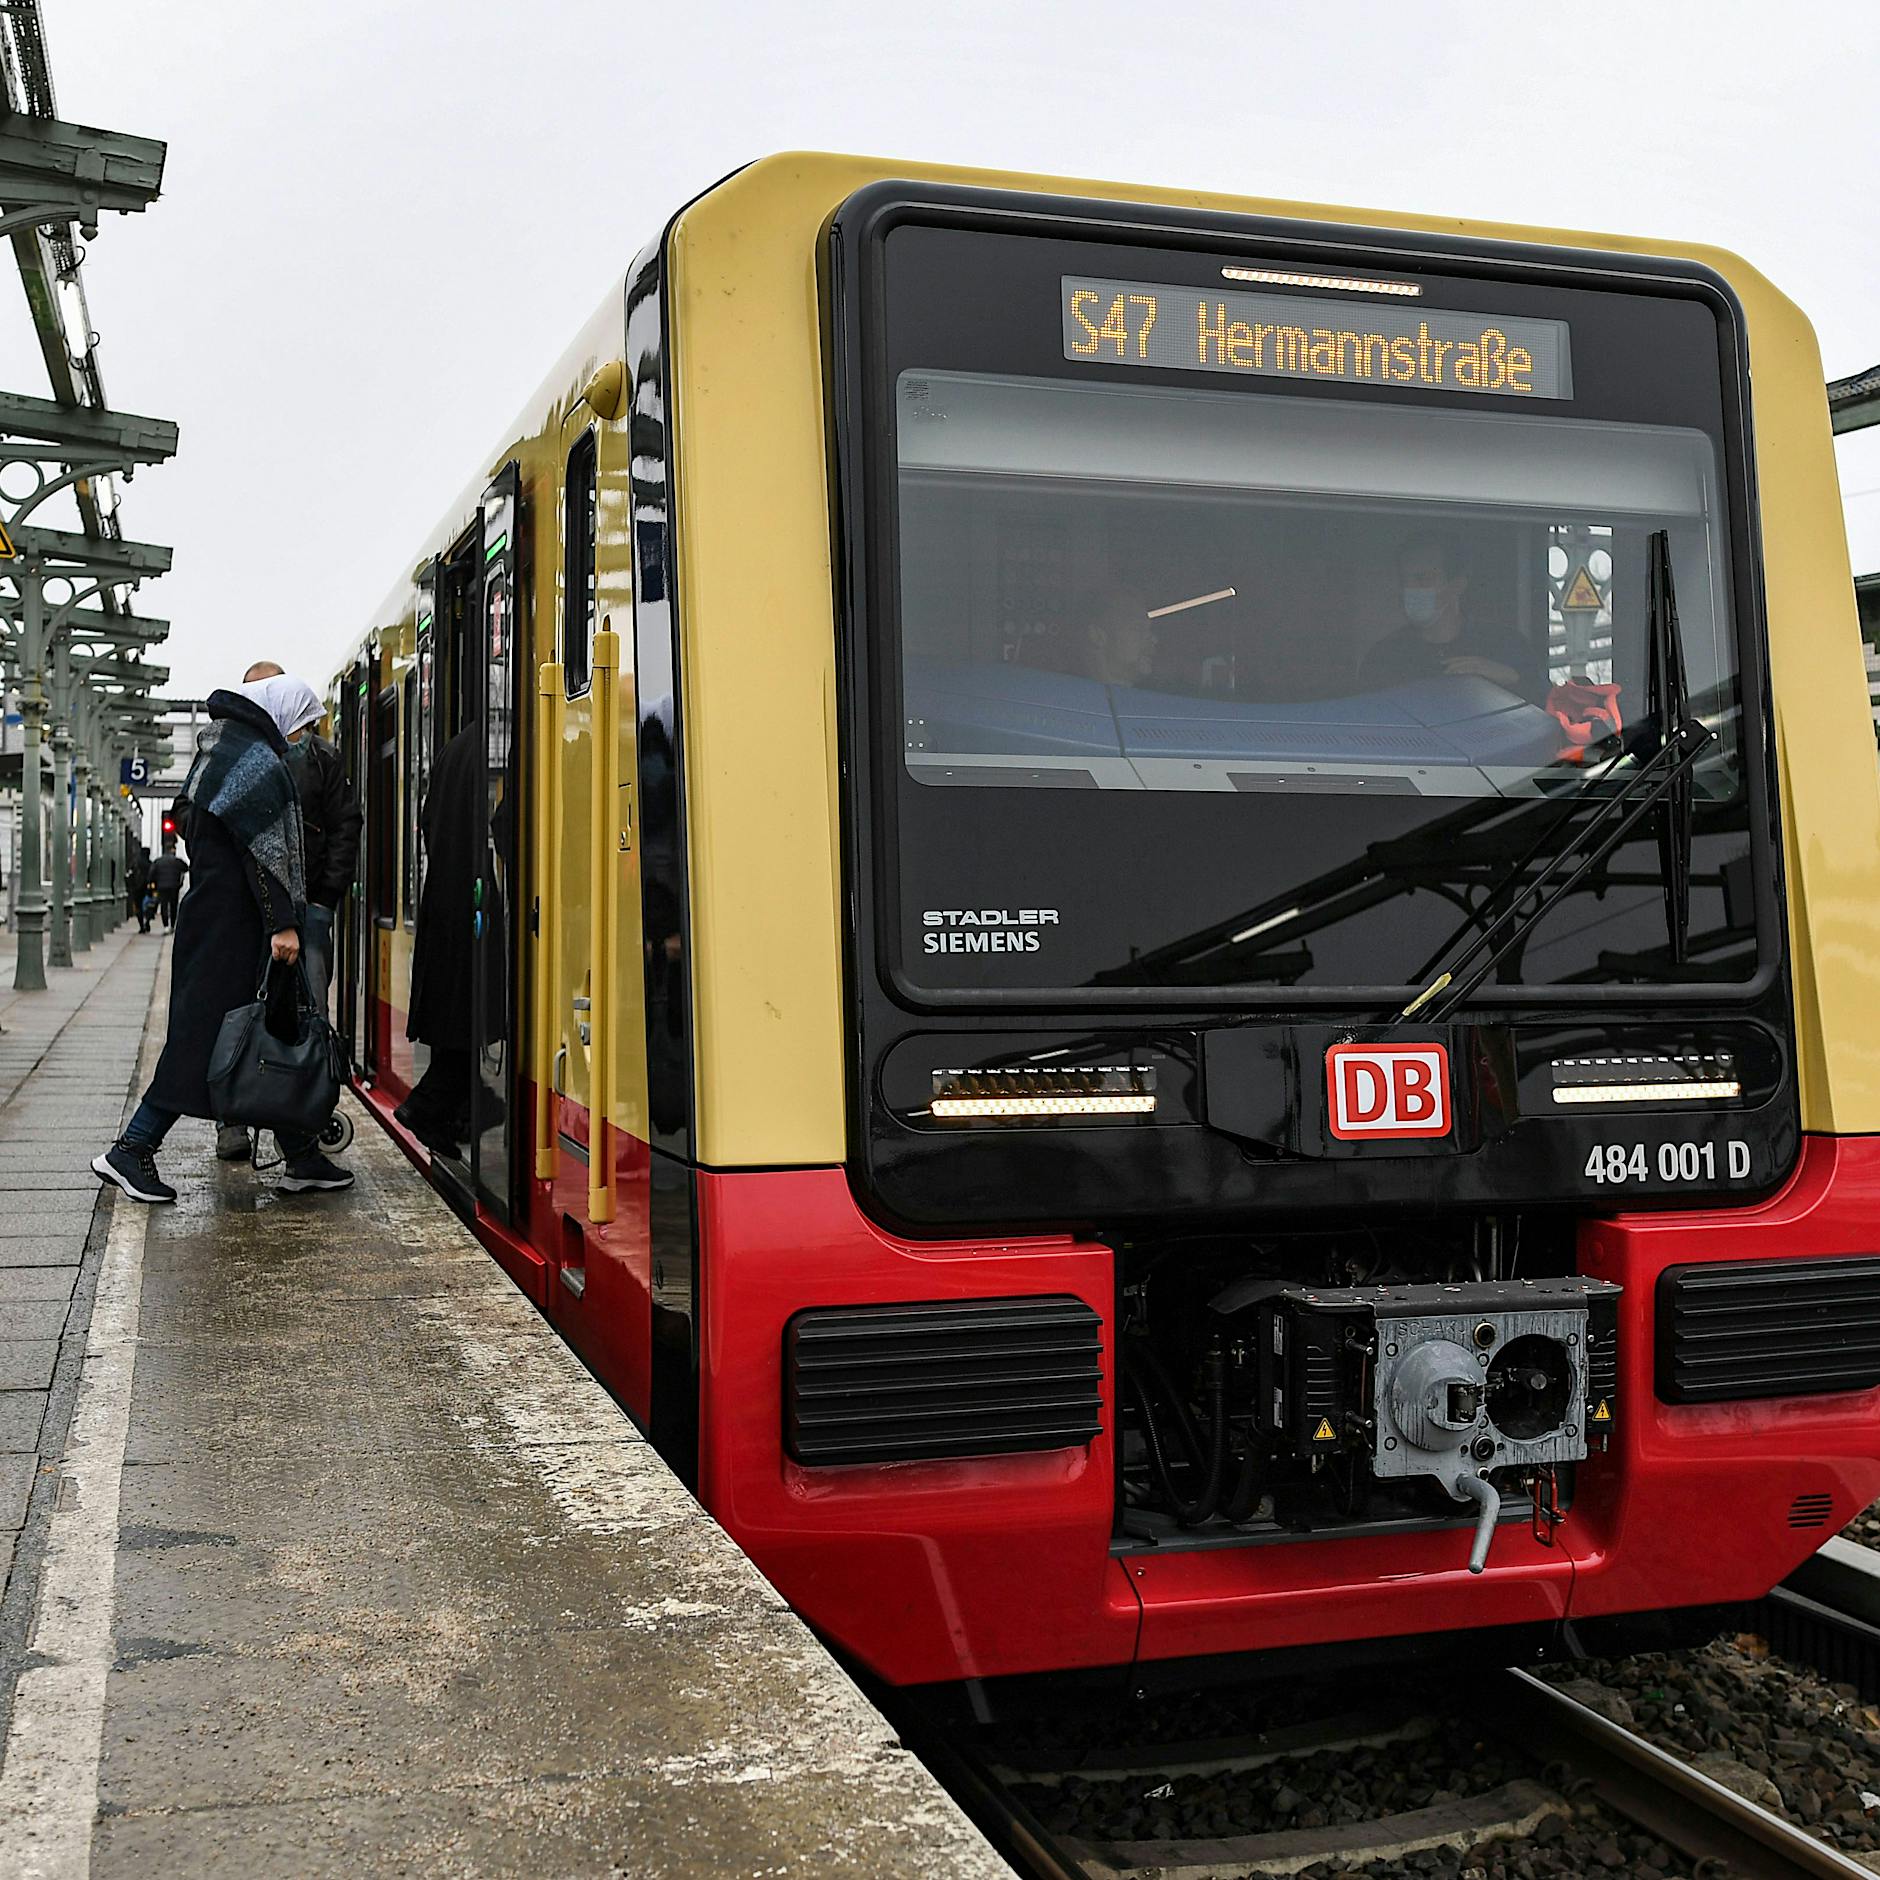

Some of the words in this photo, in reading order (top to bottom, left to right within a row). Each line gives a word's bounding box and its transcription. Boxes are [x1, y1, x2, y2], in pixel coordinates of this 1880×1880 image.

[1070, 289, 1158, 359] S47
[1197, 300, 1534, 393] Hermannstraße
[130, 758, 145, 781] 5
[922, 909, 1060, 926] STADLER
[923, 931, 1041, 954] SIEMENS
[1343, 1058, 1437, 1124] DB
[1584, 1142, 1649, 1184] 484
[1657, 1140, 1716, 1182] 001
[1728, 1140, 1751, 1179] D
